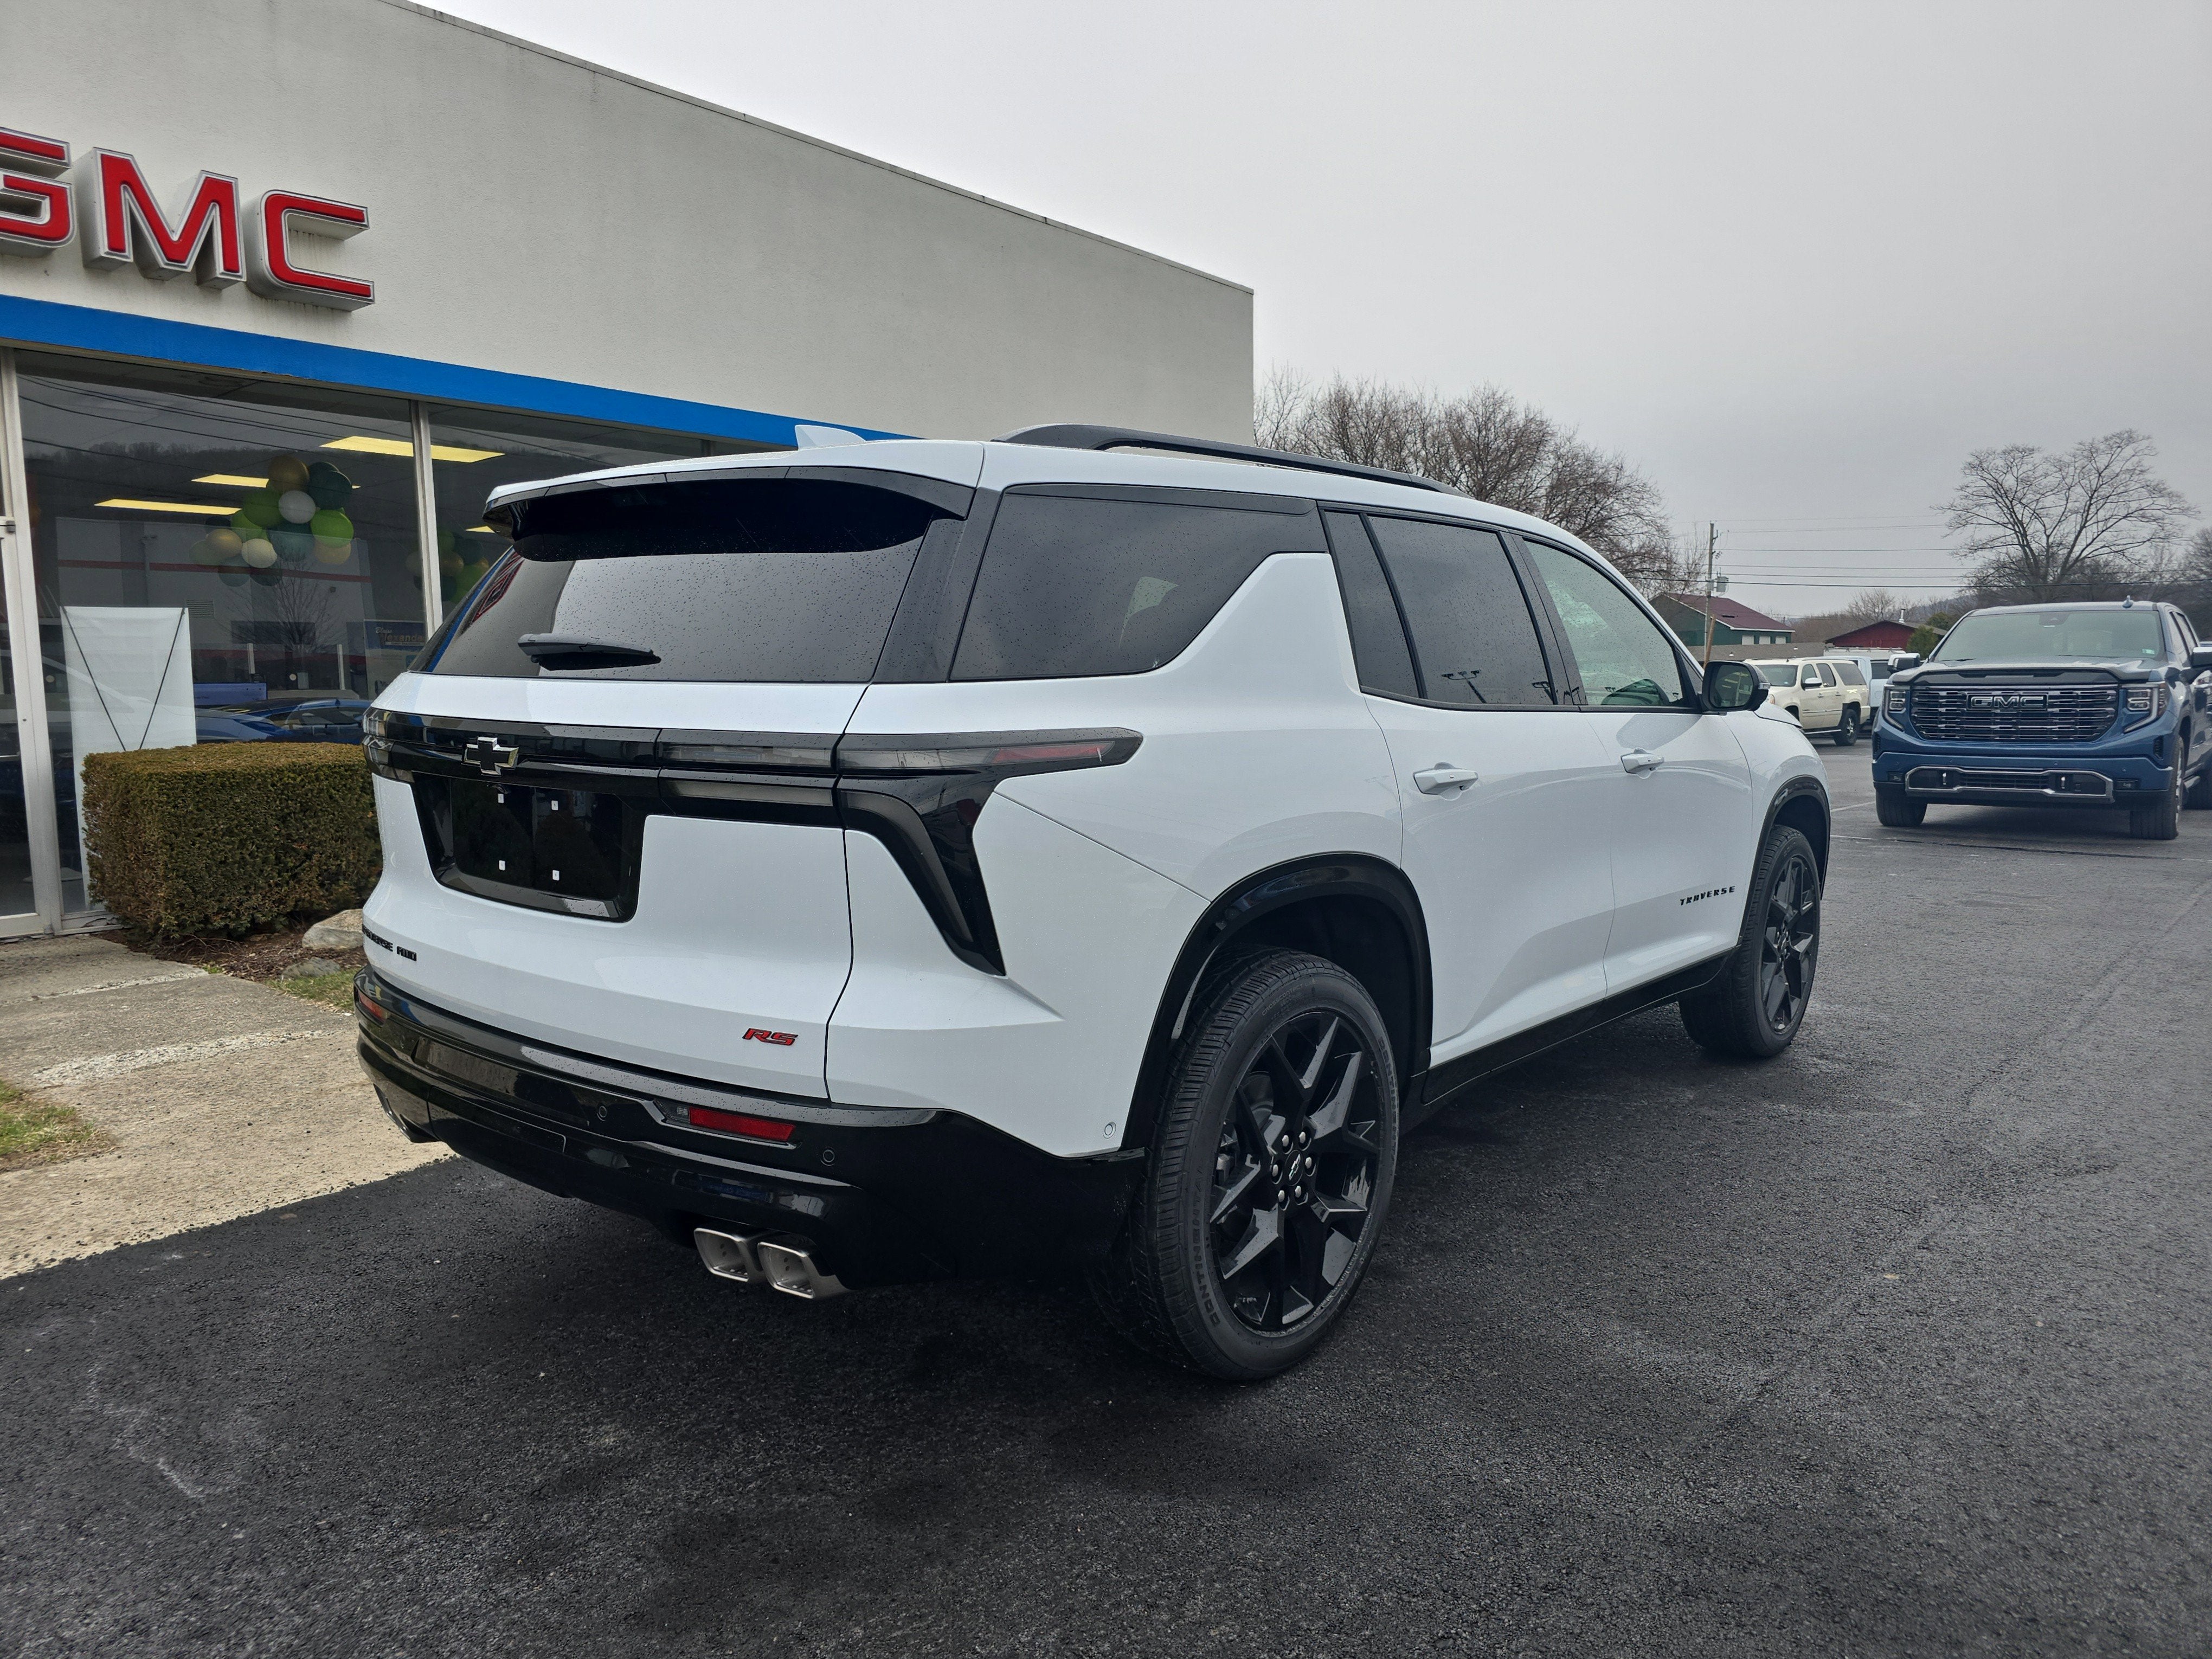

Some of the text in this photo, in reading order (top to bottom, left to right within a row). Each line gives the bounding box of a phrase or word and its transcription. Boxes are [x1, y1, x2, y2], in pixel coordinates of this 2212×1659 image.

[1970, 696, 2044, 709] GMC
[1680, 885, 1735, 906] TRAVERSE
[396, 946, 417, 962] AWD
[742, 1027, 799, 1046] RS
